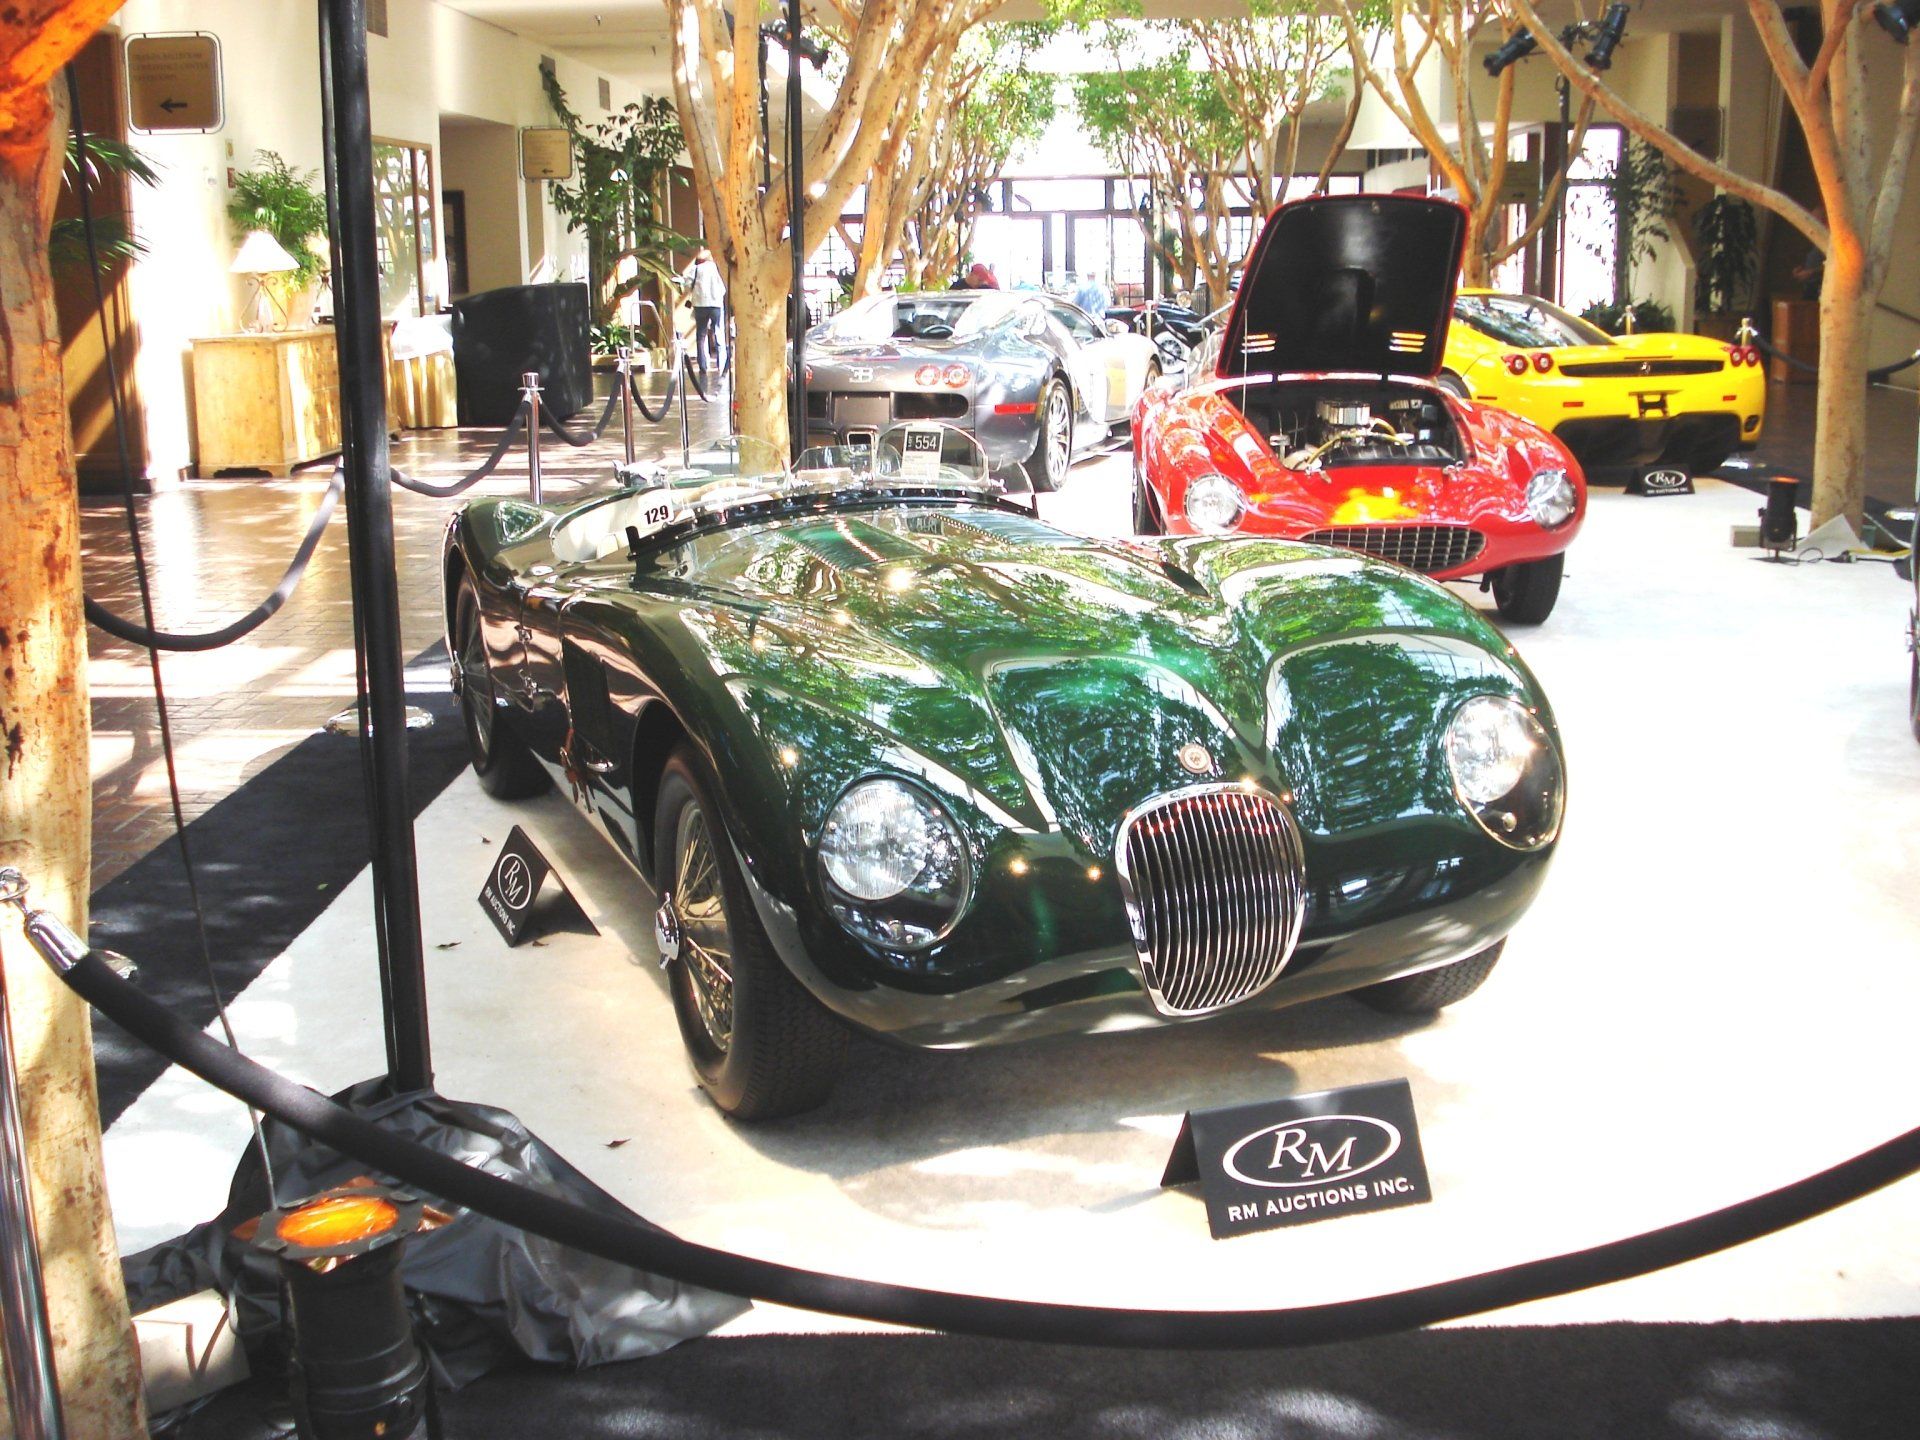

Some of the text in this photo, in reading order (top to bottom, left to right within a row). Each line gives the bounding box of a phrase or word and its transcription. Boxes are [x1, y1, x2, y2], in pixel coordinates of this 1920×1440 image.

[915, 434, 937, 450] 554
[644, 504, 669, 525] 129
[504, 860, 523, 903] RM
[1267, 1128, 1357, 1178] RM
[1228, 1176, 1415, 1222] RM AUCTIONS INC.
